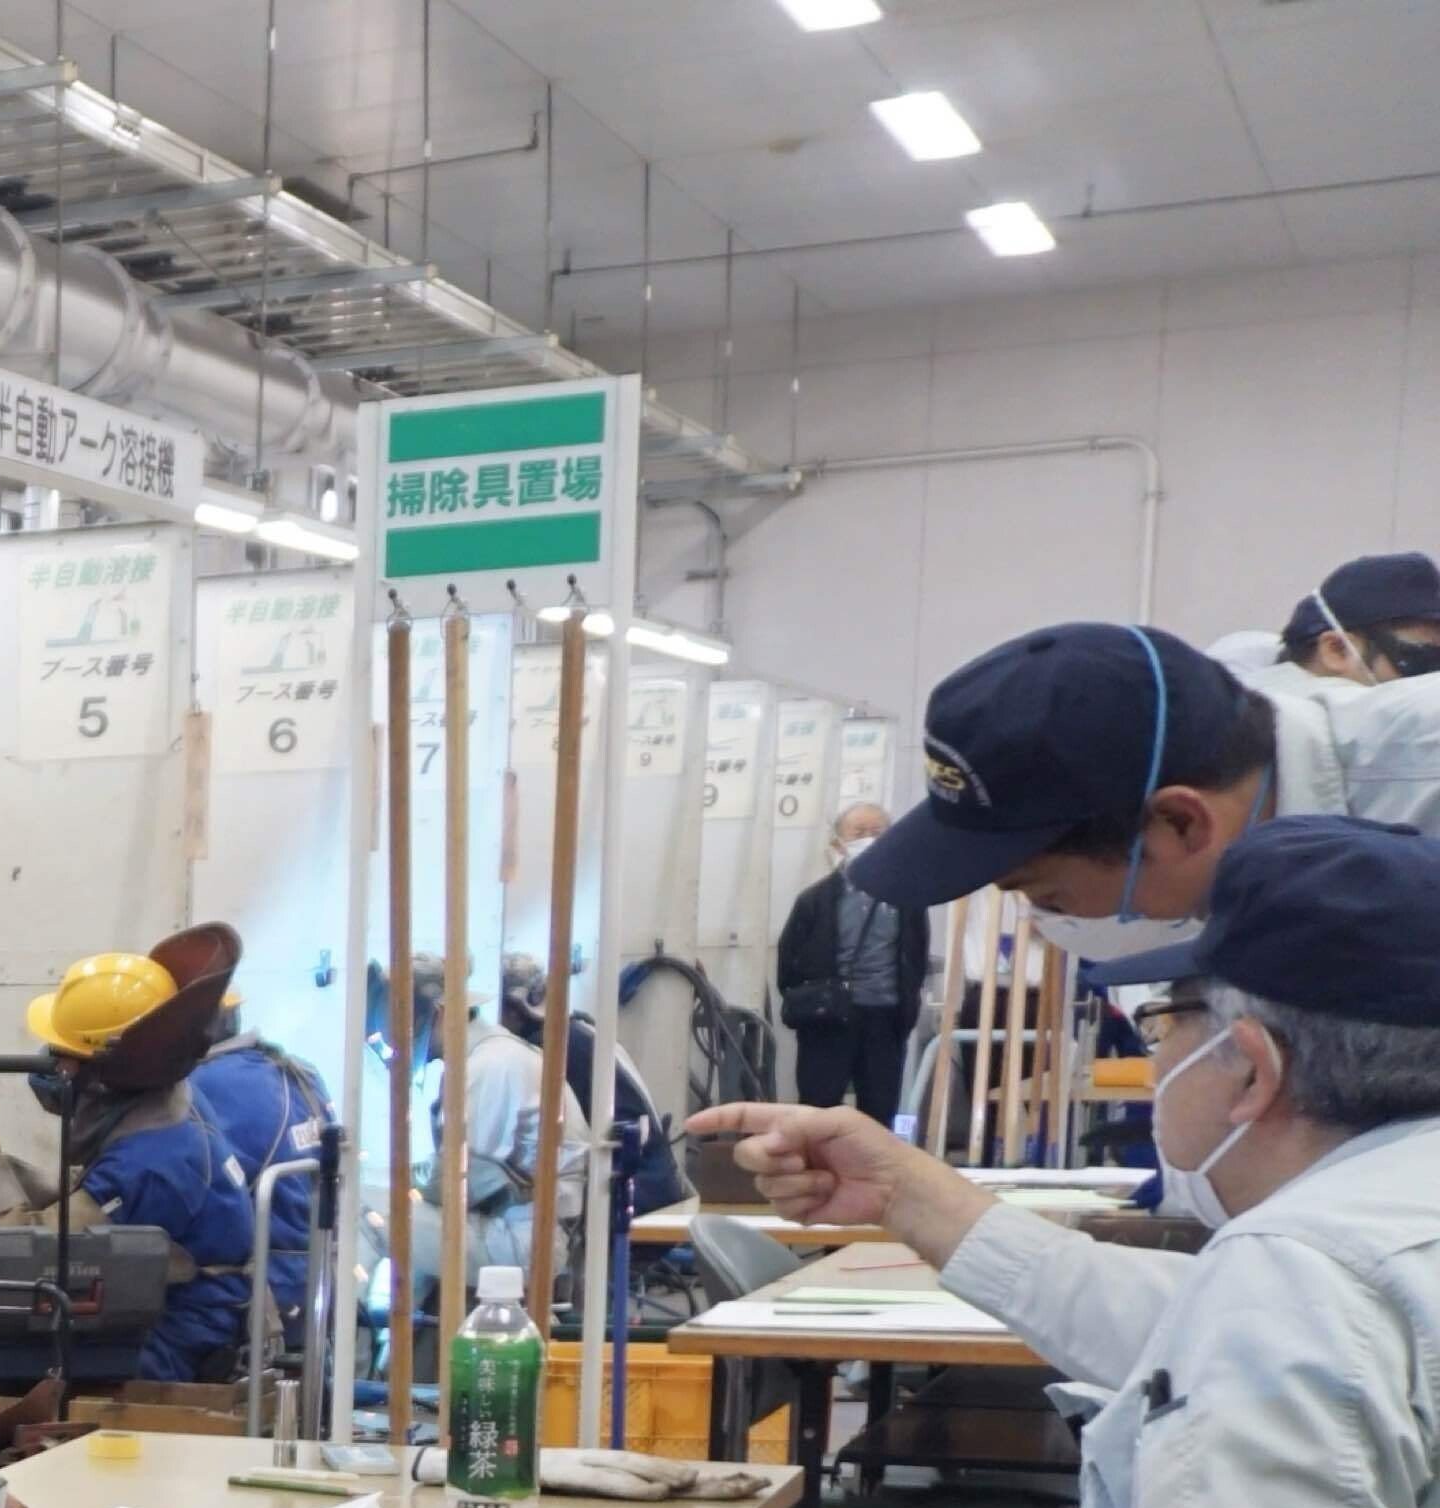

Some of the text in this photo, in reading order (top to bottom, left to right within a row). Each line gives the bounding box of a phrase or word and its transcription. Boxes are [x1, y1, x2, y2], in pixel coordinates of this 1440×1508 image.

[387, 457, 603, 517] 掃除具置場
[27, 555, 157, 590] 半自動溶接
[226, 595, 342, 624] 半自動溶接
[40, 655, 154, 682] ブース番号
[236, 681, 337, 702] ブース番号
[78, 696, 108, 738] 5
[268, 718, 297, 753] 6
[416, 742, 441, 774] 7
